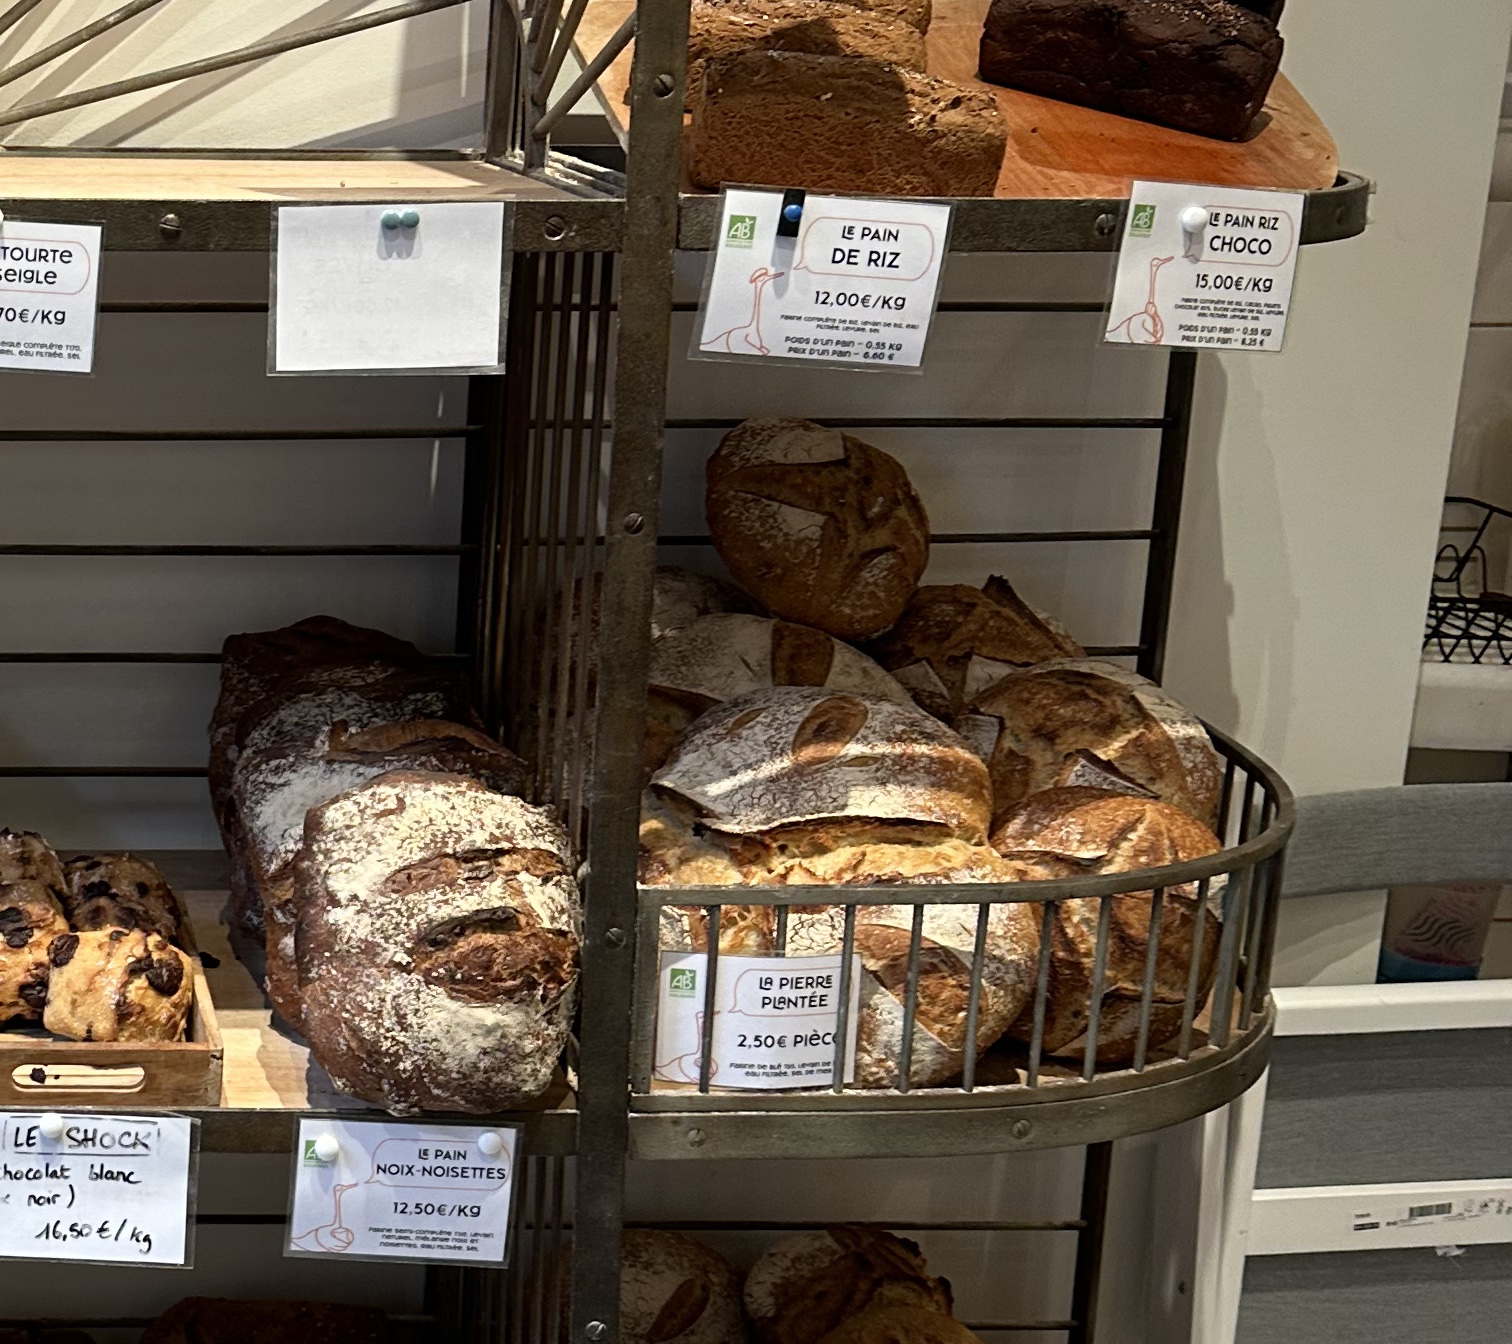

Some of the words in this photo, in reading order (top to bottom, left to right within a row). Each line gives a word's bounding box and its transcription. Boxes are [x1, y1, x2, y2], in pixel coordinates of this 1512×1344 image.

[1209, 212, 1221, 226] LE
[1224, 213, 1254, 229] PAIN
[1258, 216, 1279, 231] RIZ
[842, 225, 855, 240] LE
[860, 227, 899, 242] PAIN
[1209, 235, 1272, 255] CHOCO
[831, 247, 861, 265] DE
[867, 251, 900, 269] RIZ
[1195, 273, 1274, 293] 15,00€/Kg
[814, 290, 906, 311] 12,00€/Kg
[759, 976, 773, 990] LA
[779, 974, 833, 990] PIERRE
[761, 991, 829, 1010] PLANTÉE
[737, 1034, 787, 1049] 2,50€
[14, 1126, 39, 1147] LE
[66, 1126, 151, 1151] SHOCK
[418, 1148, 430, 1160] LE
[434, 1149, 467, 1161] PAIN
[88, 1163, 142, 1184] blanc
[376, 1163, 506, 1181] NOIX-NOISETTES
[393, 1202, 481, 1218] 12,50€/Kg
